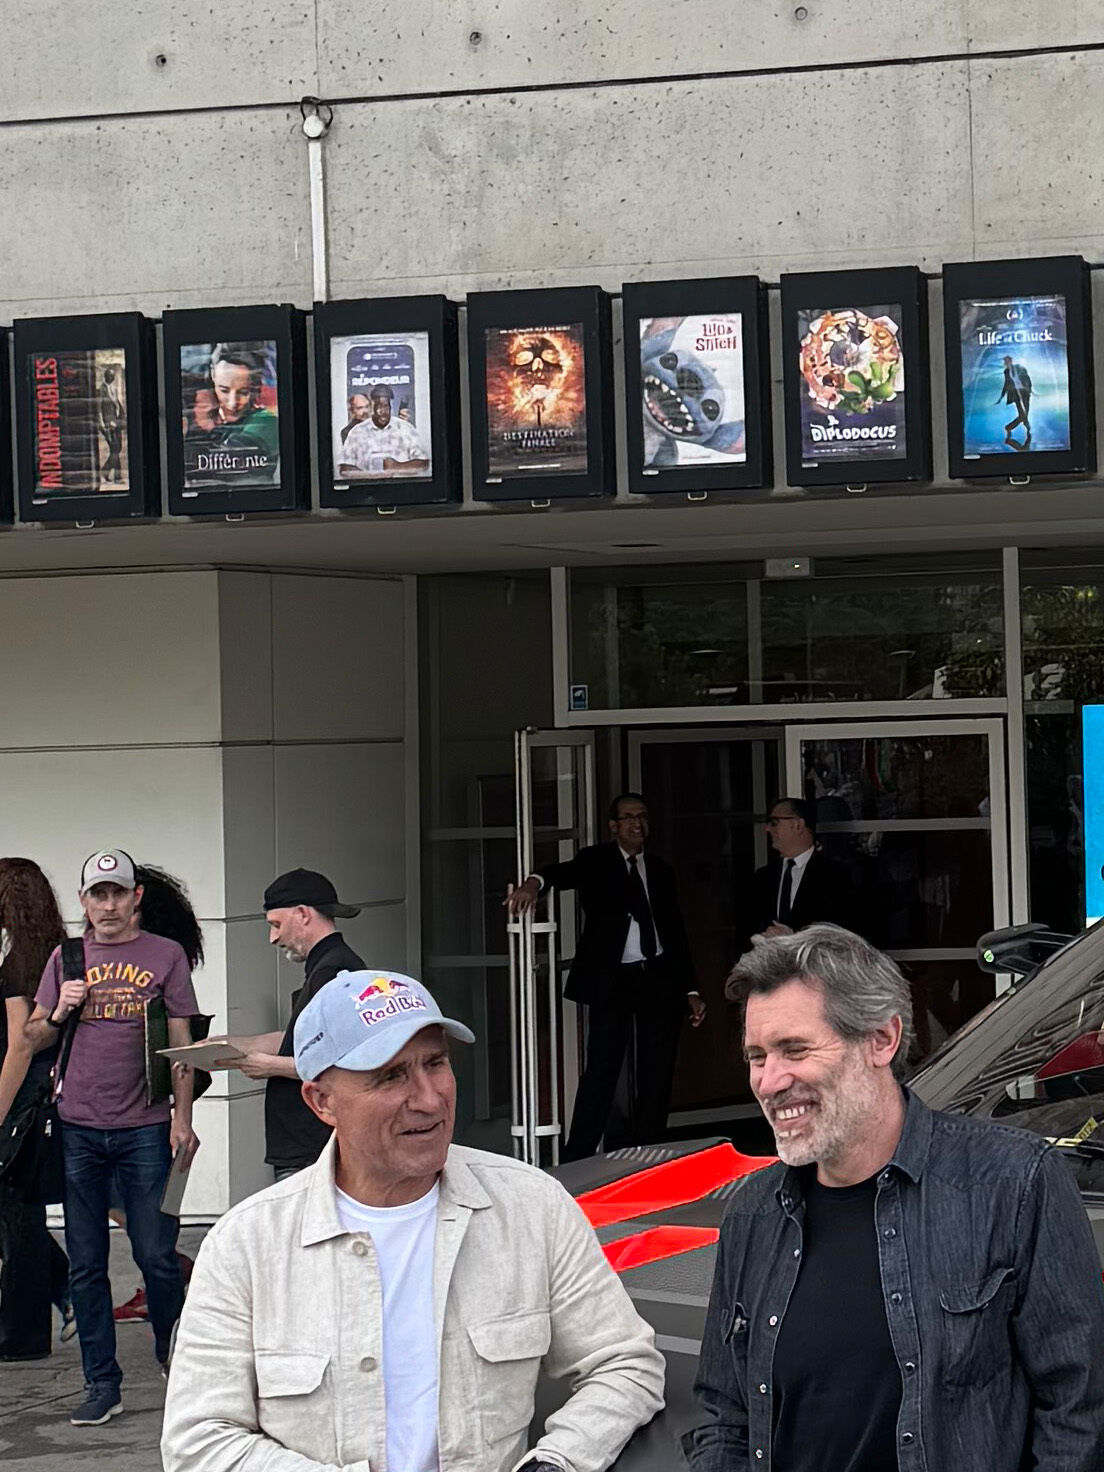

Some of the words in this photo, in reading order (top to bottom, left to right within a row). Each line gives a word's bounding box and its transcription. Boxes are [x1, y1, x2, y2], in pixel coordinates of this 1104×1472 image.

[979, 331, 1002, 346] Life
[1014, 329, 1053, 343] Chuck
[36, 357, 63, 488] INDOMPTABLES
[810, 424, 897, 442] DIPLODOCUS
[197, 453, 269, 471] Différnte
[86, 962, 155, 988] OXING
[360, 997, 401, 1028] Red
